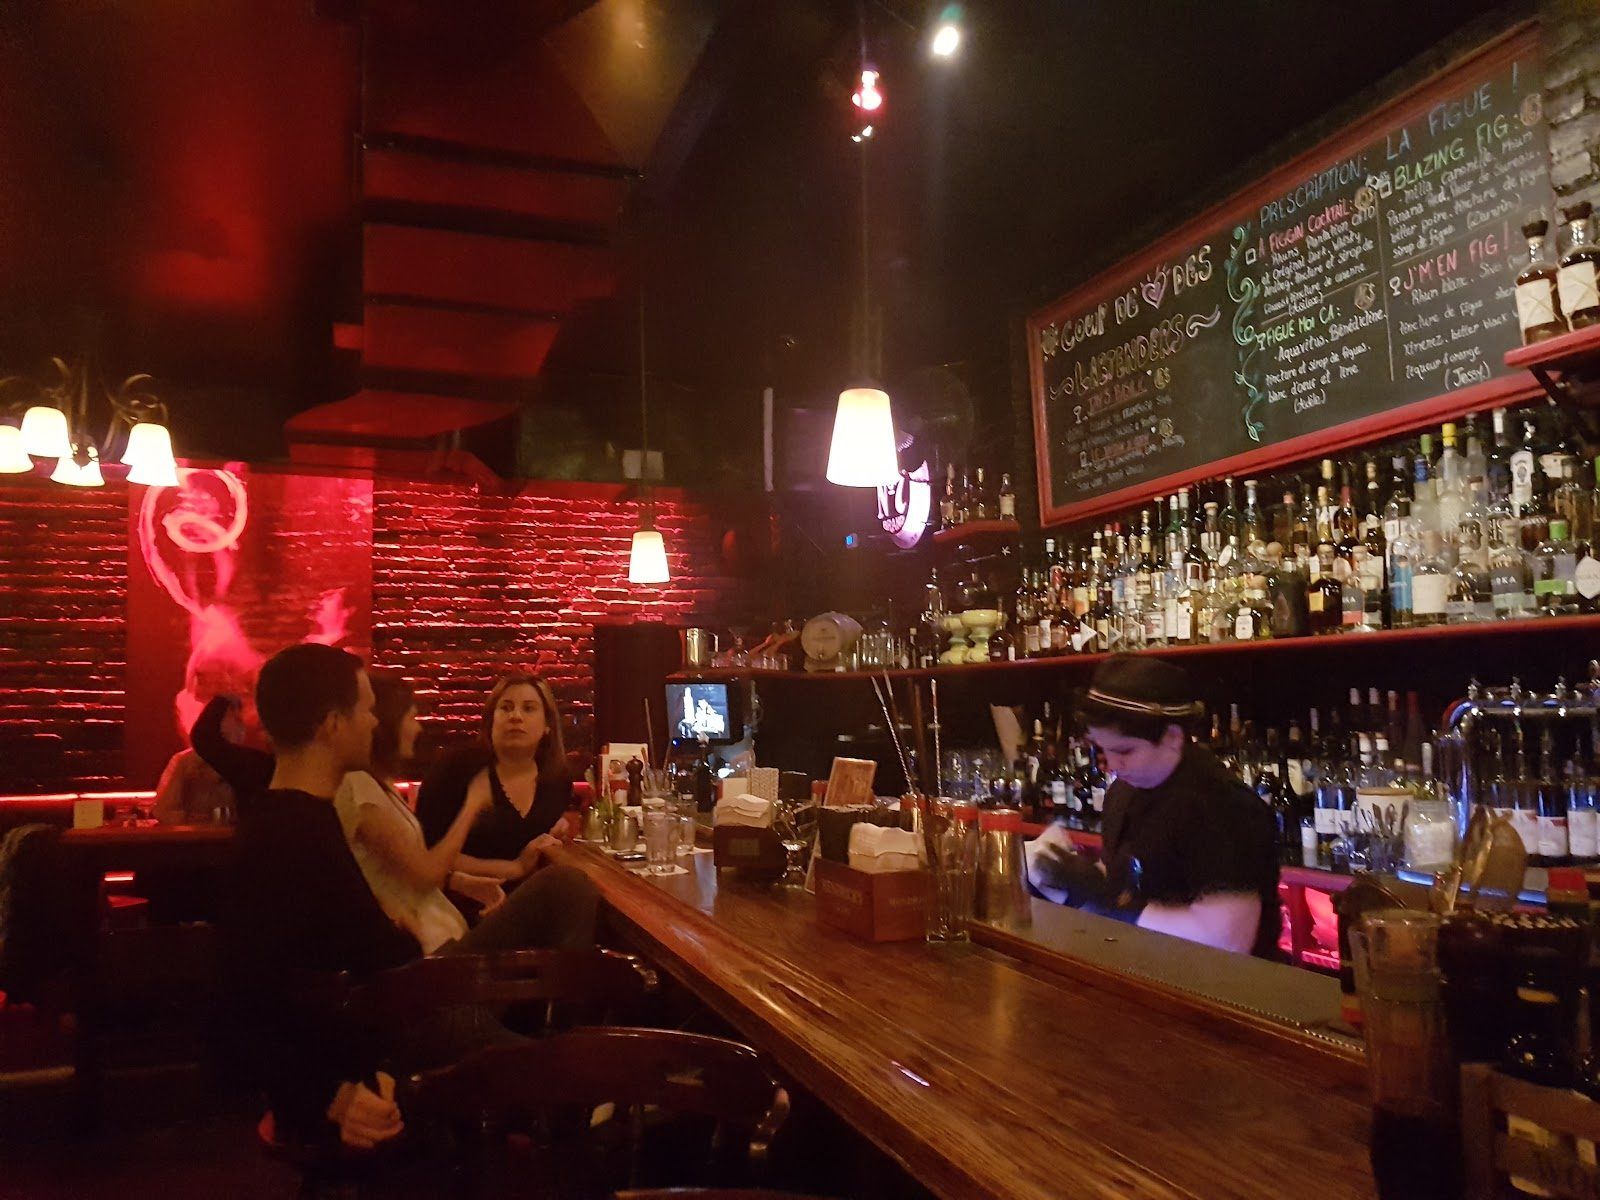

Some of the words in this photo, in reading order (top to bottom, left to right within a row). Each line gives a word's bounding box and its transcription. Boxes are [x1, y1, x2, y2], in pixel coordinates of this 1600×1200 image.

[1386, 128, 1412, 161] LA
[1428, 82, 1492, 136] FIGUE
[1394, 137, 1465, 190] BLAZING
[1411, 288, 1439, 306] Rhum
[1266, 320, 1295, 346] FIGUE
